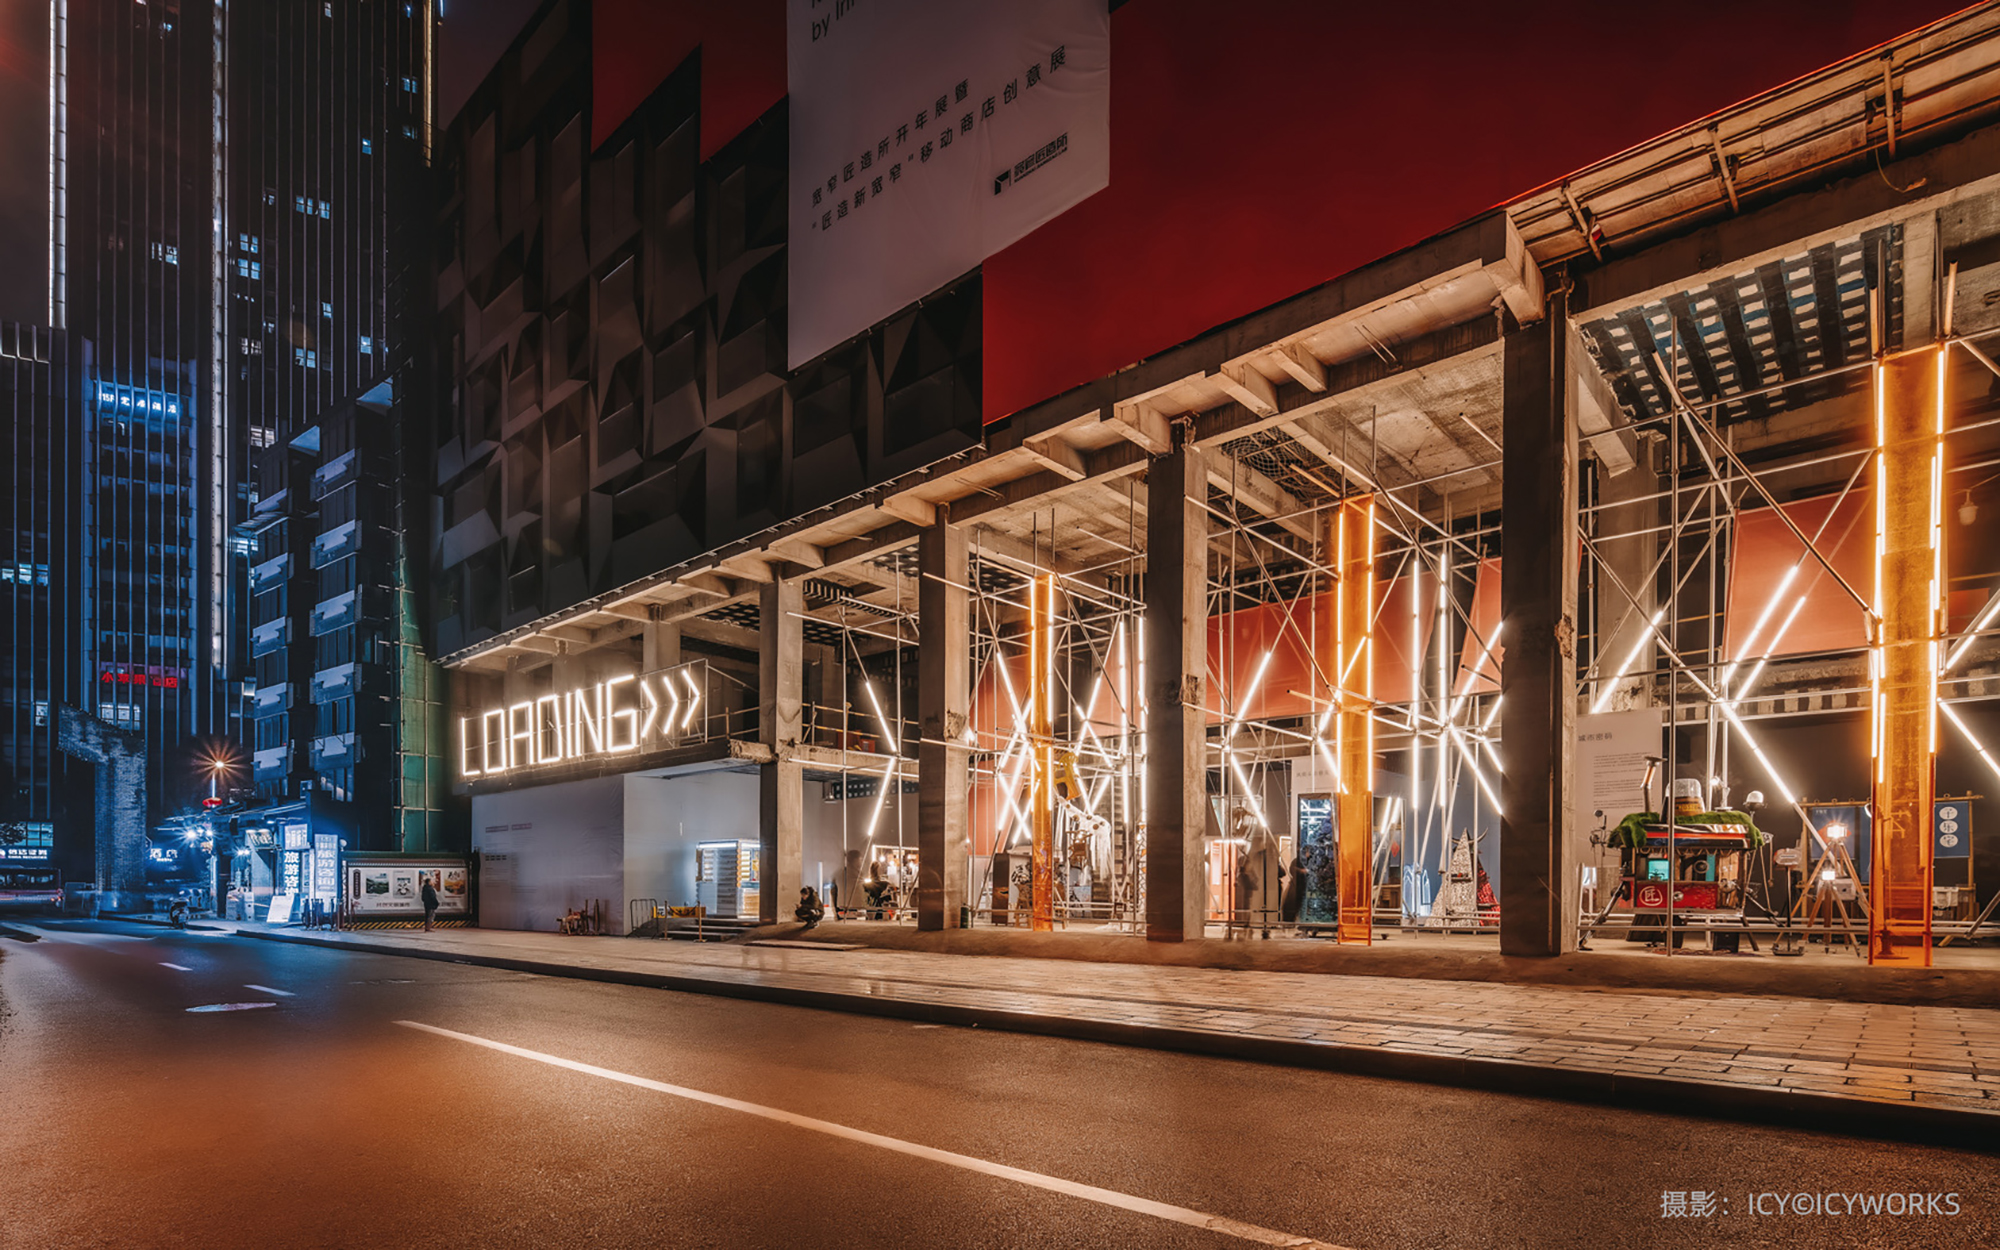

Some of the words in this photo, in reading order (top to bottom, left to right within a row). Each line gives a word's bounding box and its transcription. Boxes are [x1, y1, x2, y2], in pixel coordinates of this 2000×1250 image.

[812, 12, 831, 43] by
[811, 78, 970, 208] 宽窄匠造所开年展暨
[461, 674, 636, 776] LOADING
[150, 848, 178, 859] 酒店
